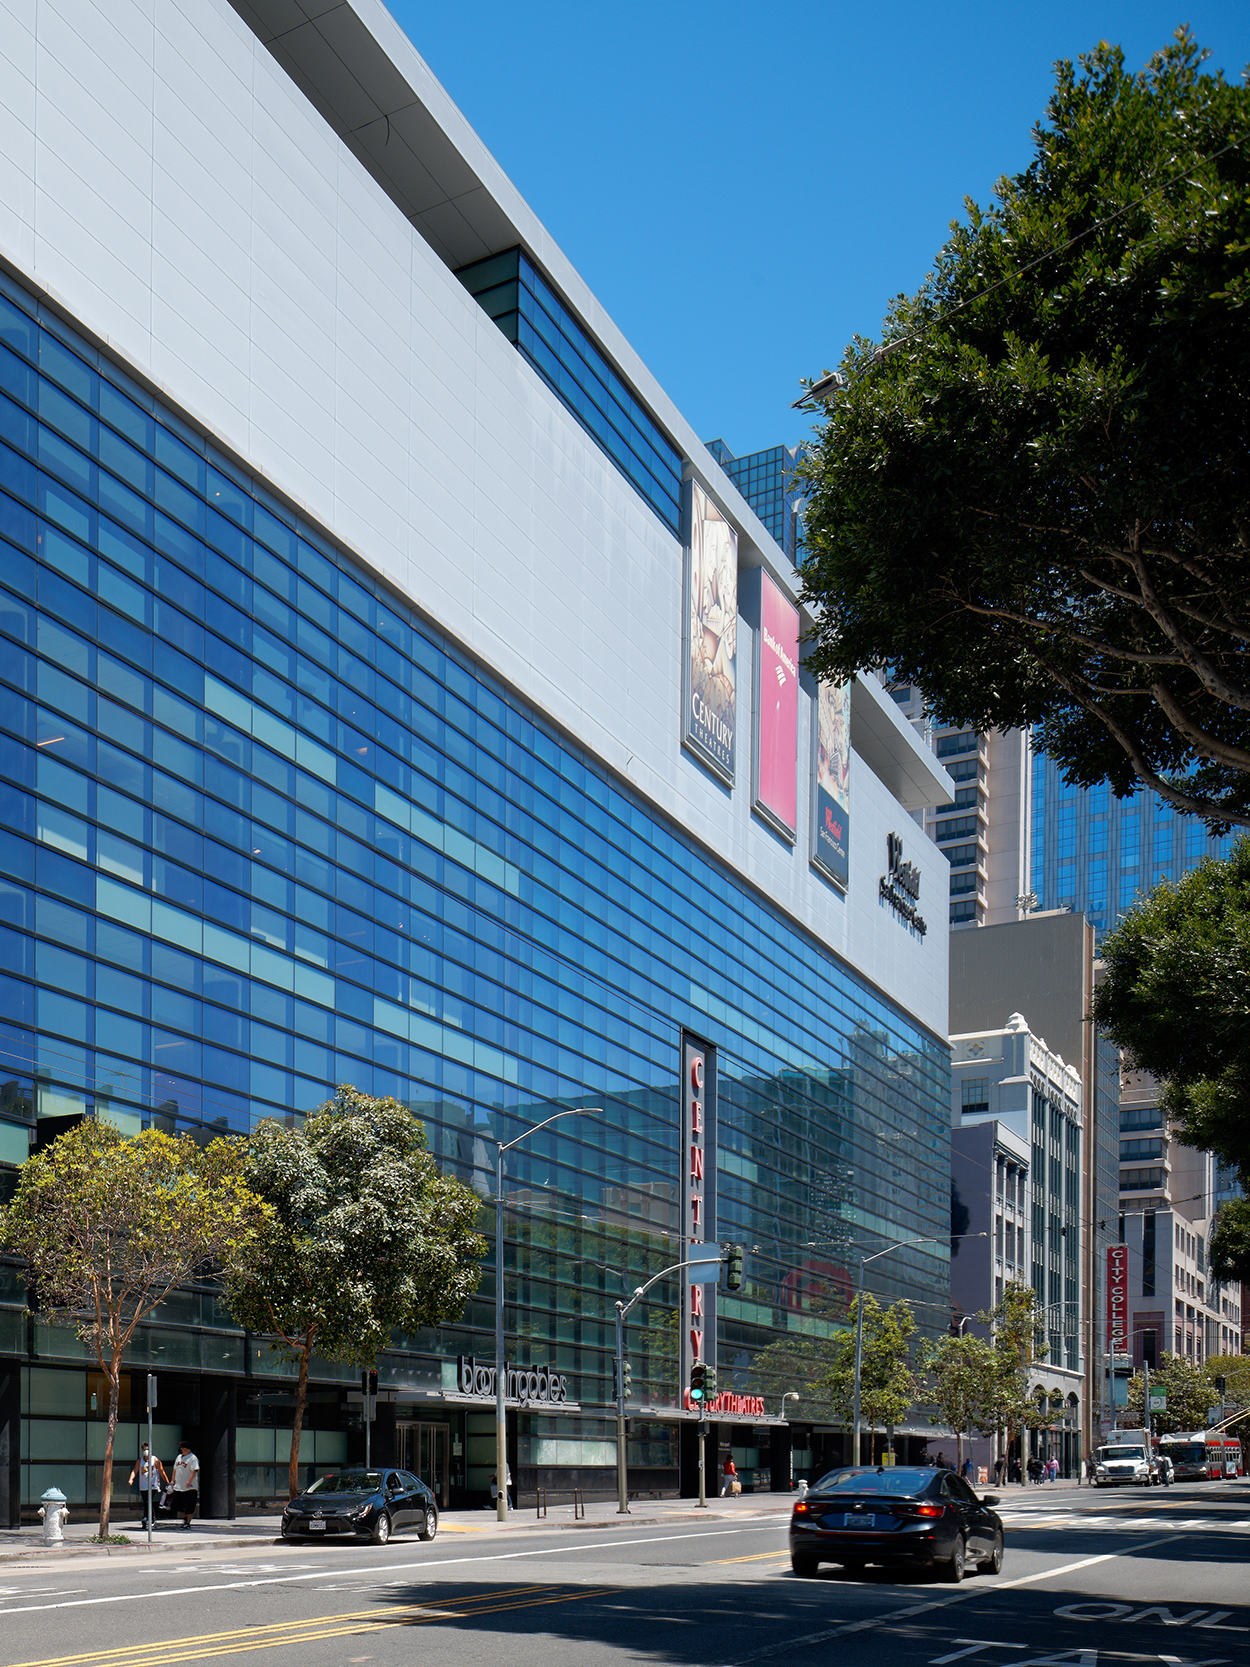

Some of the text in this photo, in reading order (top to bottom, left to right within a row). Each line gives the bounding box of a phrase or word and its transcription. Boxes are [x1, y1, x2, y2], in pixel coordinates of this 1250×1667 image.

[763, 626, 776, 653] Bank
[780, 646, 796, 677] America
[692, 692, 733, 751] CENTURY
[694, 723, 730, 764] THEATRES
[690, 1056, 705, 1362] CENTRY
[1111, 1250, 1124, 1284] CITY
[723, 1391, 765, 1416] THEATRES
[1053, 1602, 1250, 1631] ONL
